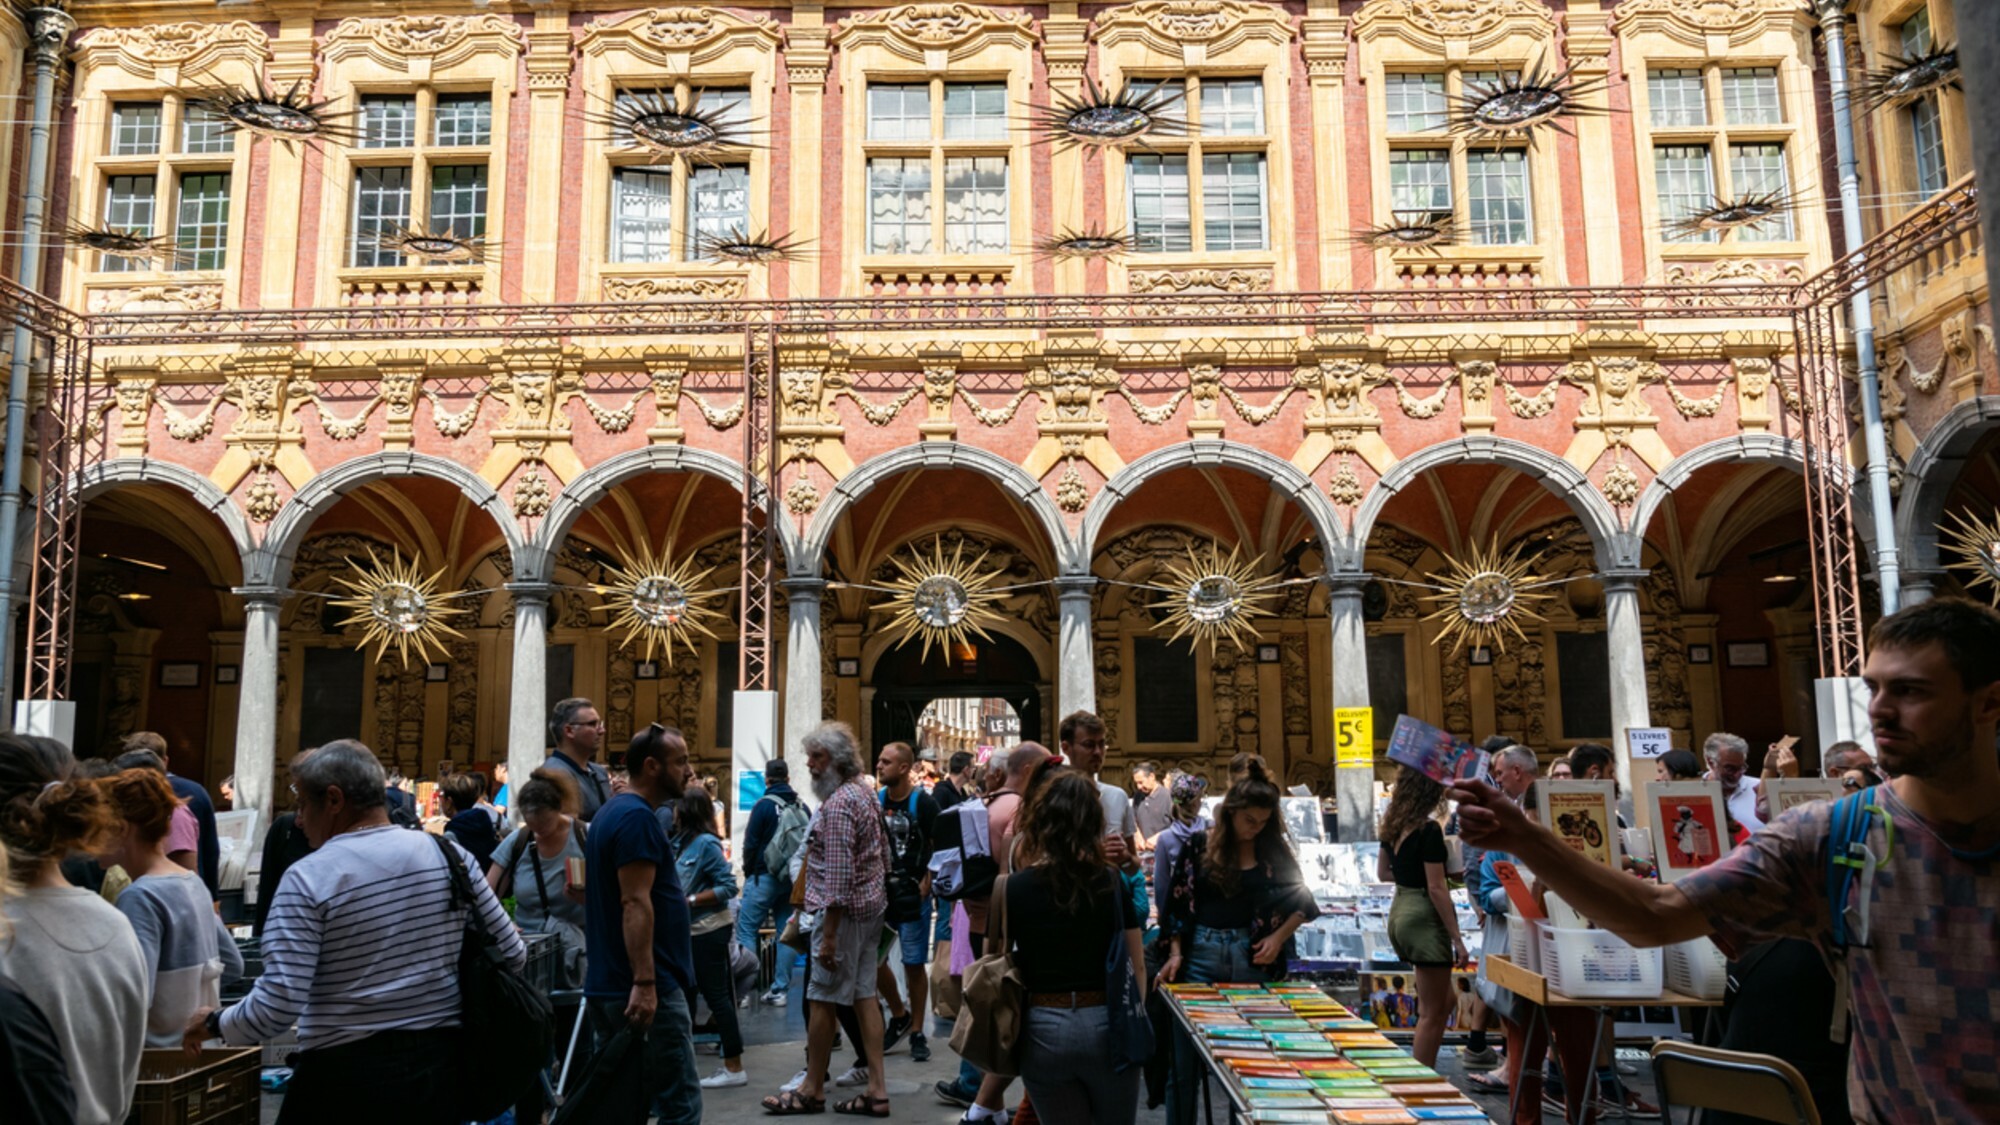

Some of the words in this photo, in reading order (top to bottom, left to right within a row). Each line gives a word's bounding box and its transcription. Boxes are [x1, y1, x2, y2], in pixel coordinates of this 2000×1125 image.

[991, 719, 1004, 733] LE
[1631, 732, 1637, 740] 5
[1638, 732, 1667, 740] LIVRES
[1642, 743, 1660, 755] 5€
